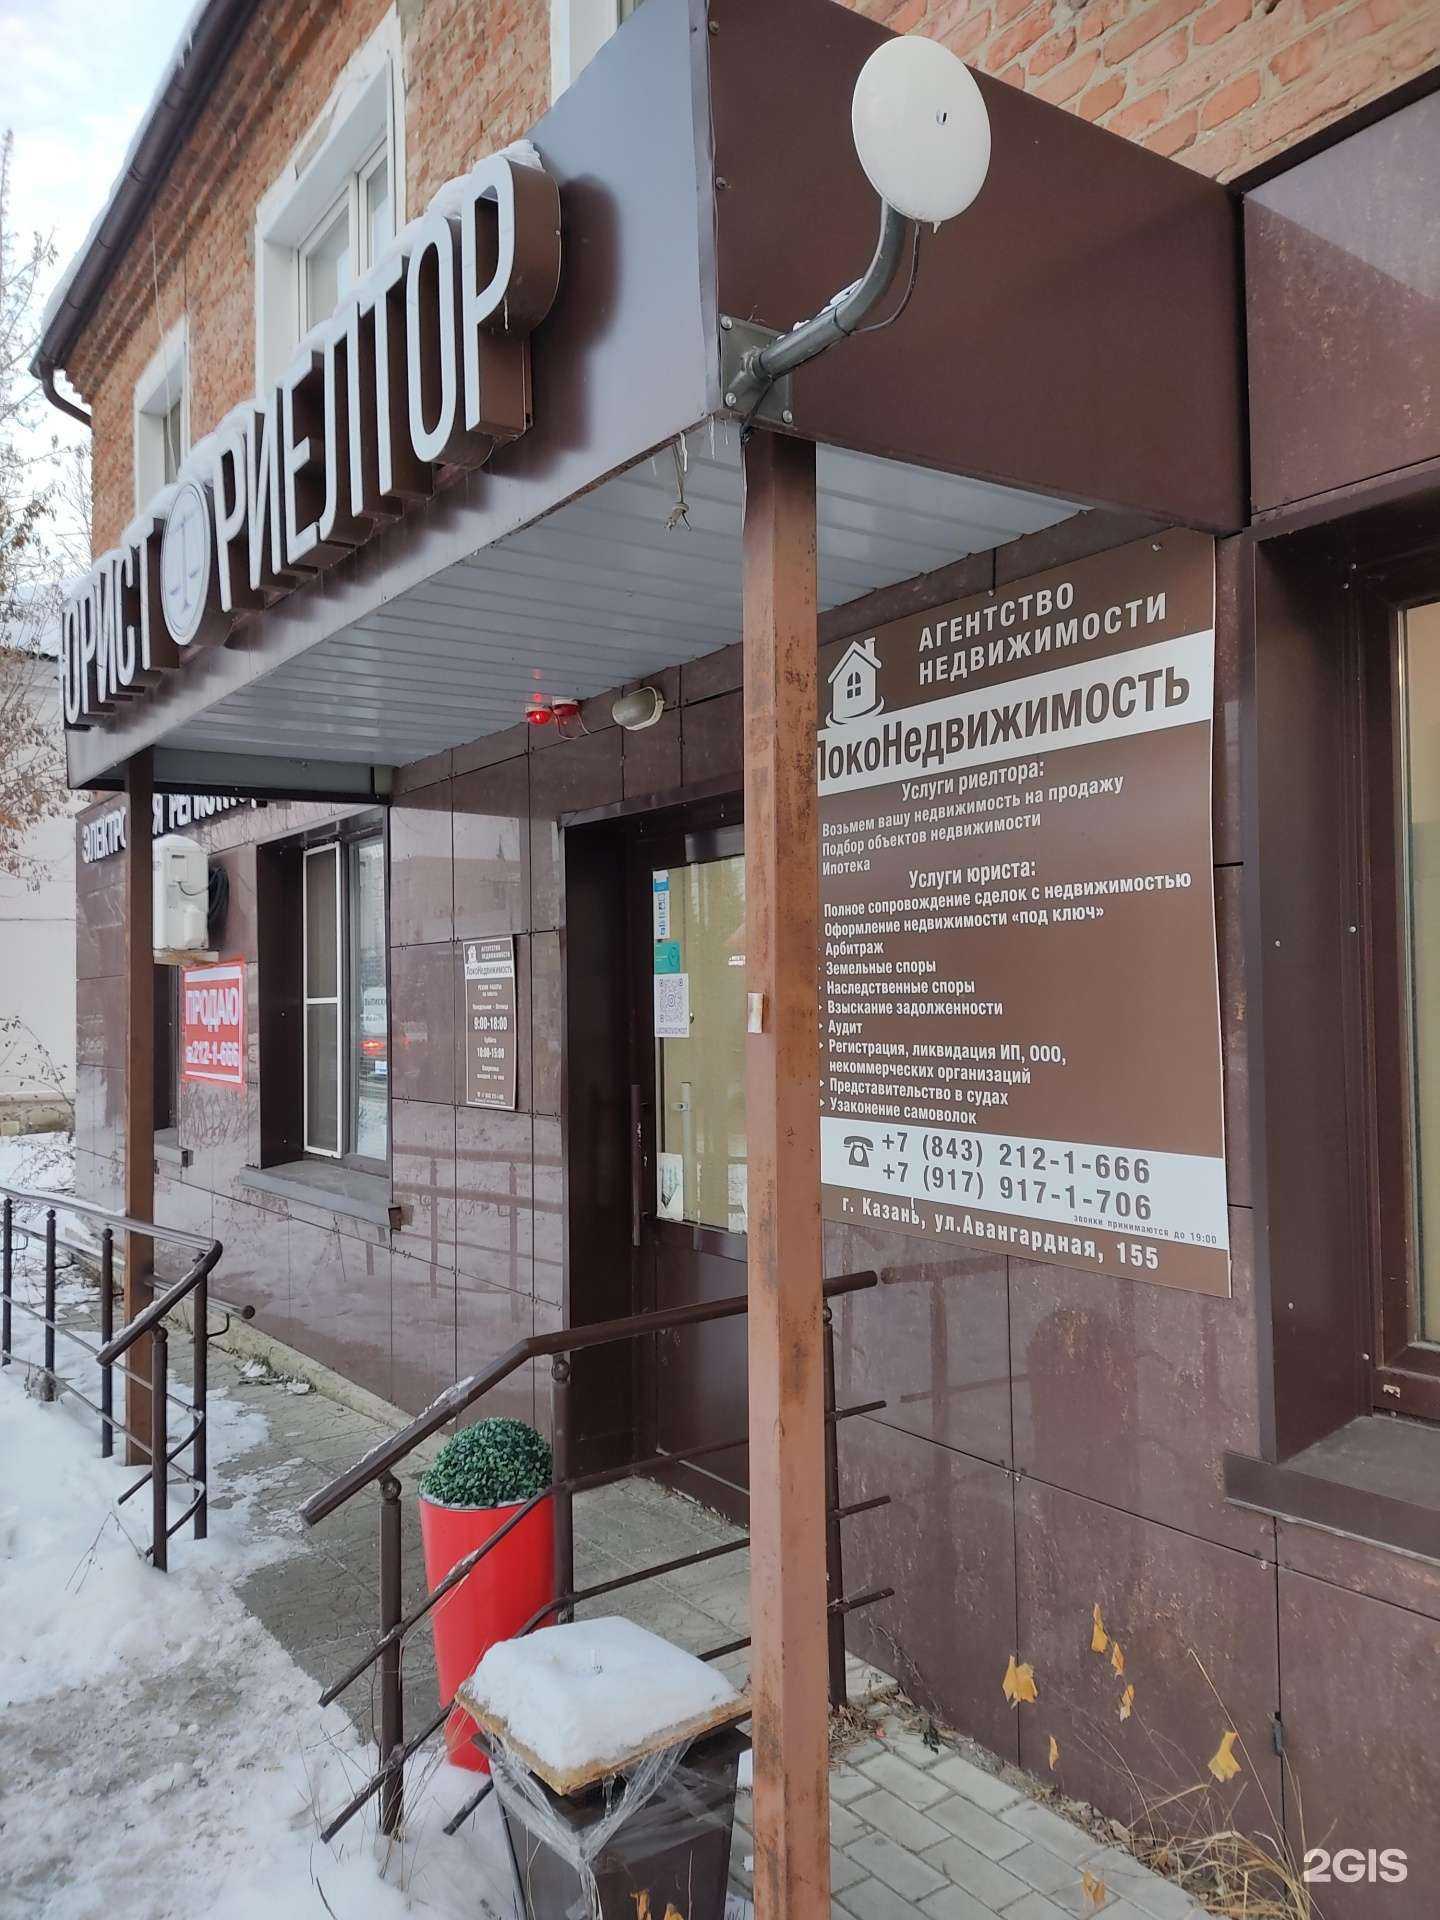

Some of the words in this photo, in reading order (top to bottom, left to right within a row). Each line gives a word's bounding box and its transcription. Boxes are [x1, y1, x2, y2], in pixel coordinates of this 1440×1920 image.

[213, 155, 516, 613] РИЕЛТОР
[918, 582, 1074, 652] АГЕНТСТВО
[919, 592, 1167, 686] НЕДВИЖИМОСТИ
[902, 778, 954, 802] Услуги
[958, 761, 1045, 795] риелтора:
[822, 818, 875, 837] Возьмем
[878, 812, 911, 828] вашу
[914, 793, 1021, 823] недвижимость
[1025, 790, 1044, 805] на
[1048, 776, 1124, 803] продажу
[822, 838, 865, 857] Подбор
[868, 830, 927, 850] объектов
[930, 813, 1041, 842] недвижимости
[822, 859, 871, 876] Ипотека
[909, 868, 962, 890] Услуги
[967, 860, 1036, 885] юриста:
[824, 902, 865, 918] Полное
[868, 894, 971, 915] сопровождение
[974, 888, 1027, 906] сделок
[1031, 887, 1040, 900] с
[1044, 872, 1192, 900] недвижимостью
[824, 920, 901, 939] Оформление
[903, 912, 1008, 933] недвижимости
[1011, 909, 1049, 926] «под
[1052, 905, 1104, 922] ключ»
[825, 941, 884, 959] Арбитраж
[826, 961, 893, 975] Земельные
[895, 960, 937, 976] споры
[826, 980, 929, 996] Наследственные
[931, 980, 976, 996] споры
[185, 986, 239, 1033] ПРОДАЮ
[827, 1000, 893, 1014] Взыскание
[896, 1002, 1003, 1017] задолженности
[828, 1019, 863, 1036] Аудит
[829, 1038, 909, 1058] Регистрация,
[912, 1044, 996, 1062] ликвидация
[1000, 1044, 1025, 1063] ИП,
[1029, 1045, 1067, 1066] ООО,
[829, 1060, 934, 1078] некоммерческих
[937, 1067, 1031, 1086] организаций
[829, 1077, 951, 1102] Представительство
[955, 1090, 963, 1101] в
[966, 1090, 1009, 1106] судах
[830, 1097, 901, 1117] Узаконение
[904, 1105, 977, 1125] самоволок
[881, 1131, 908, 1153] +7
[922, 1133, 983, 1167] (843)
[999, 1143, 1151, 1184] 212-1-666
[882, 1161, 909, 1183] +7
[923, 1165, 984, 1199] (917)
[999, 1176, 1152, 1220] 917-1-706
[842, 1197, 854, 1213] г.
[862, 1197, 926, 1230] Казань,
[934, 1212, 1104, 1264] ул.Авангардная,
[1116, 1241, 1159, 1270] 155
[1073, 1215, 1103, 1226] звонки
[1107, 1220, 1169, 1237] принимаются
[1174, 1231, 1185, 1240] до
[1190, 1232, 1217, 1244] 19:00
